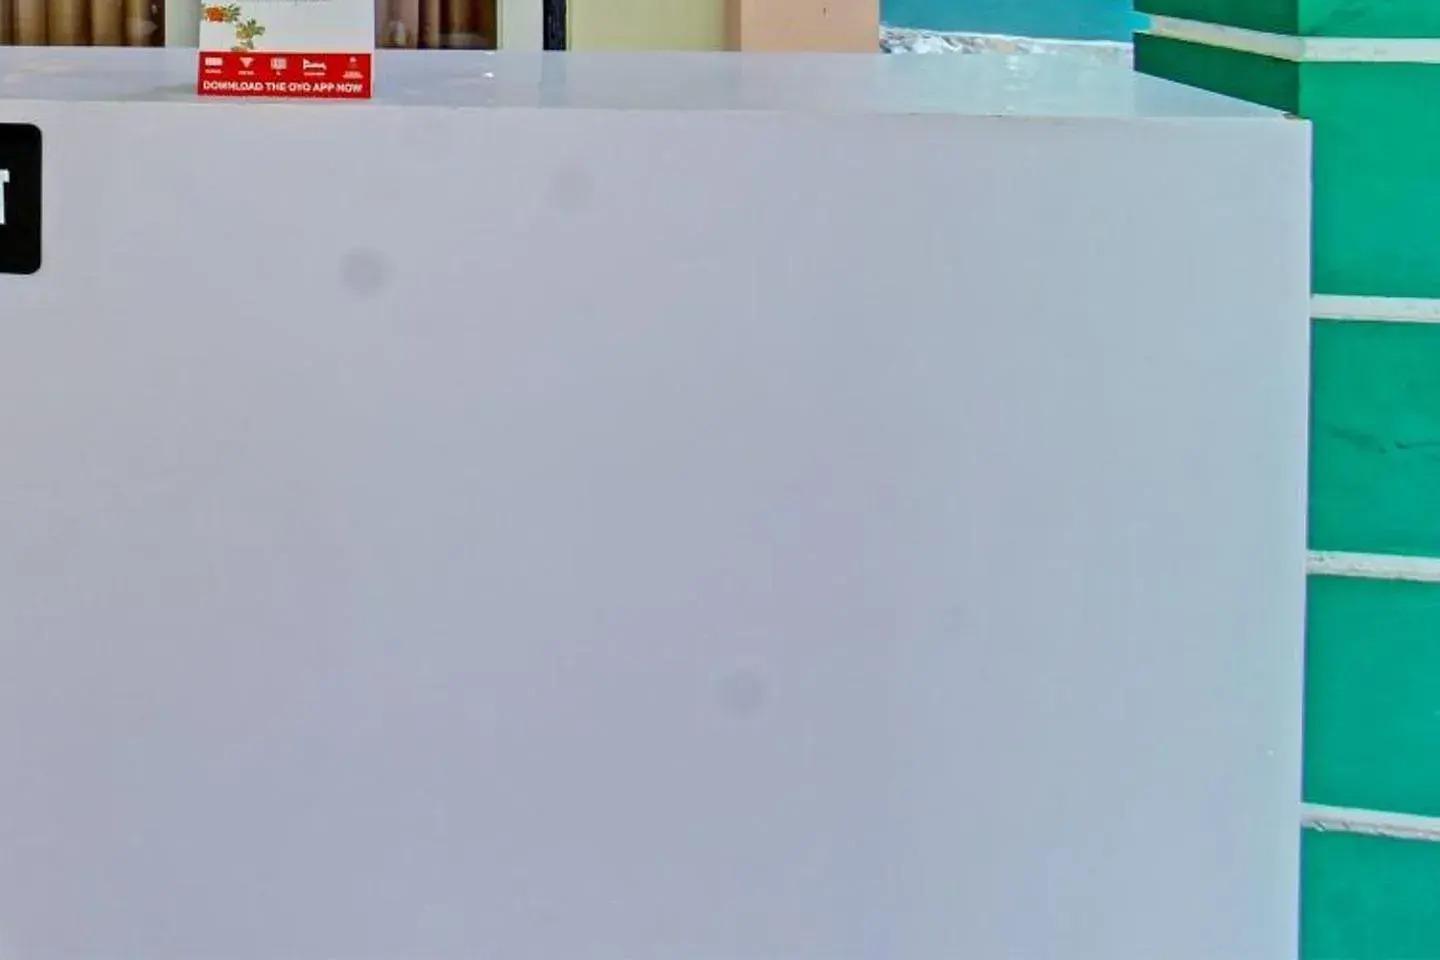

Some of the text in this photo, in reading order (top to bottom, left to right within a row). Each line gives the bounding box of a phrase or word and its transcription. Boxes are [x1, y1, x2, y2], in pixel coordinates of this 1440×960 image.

[203, 80, 363, 93] DOWNLOAD THE OYO APP NOW
